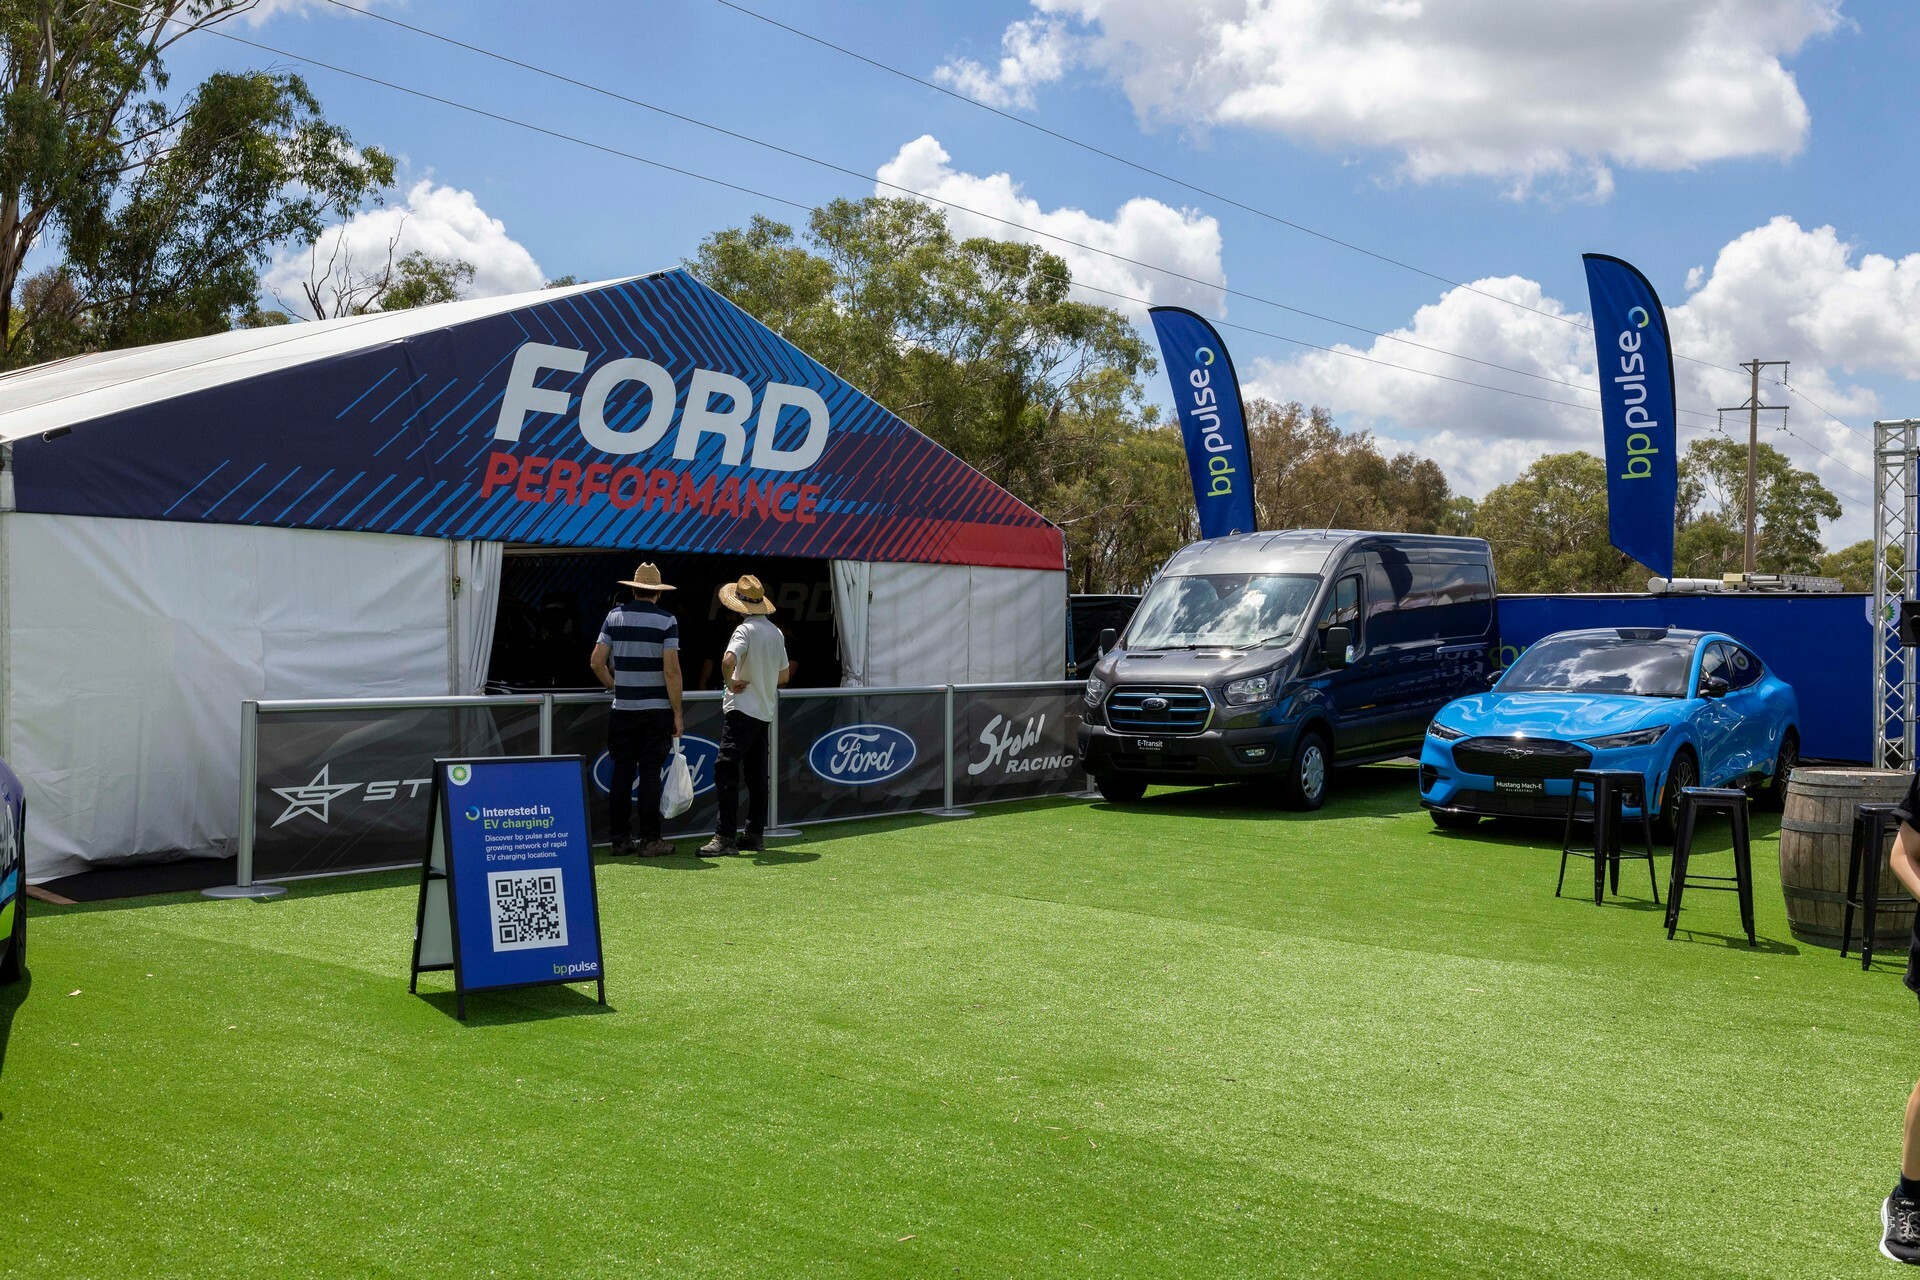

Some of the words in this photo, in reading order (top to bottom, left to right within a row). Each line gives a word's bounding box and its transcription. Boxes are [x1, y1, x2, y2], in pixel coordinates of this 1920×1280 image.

[493, 341, 831, 472] FORD
[480, 451, 822, 524] PERFORMANCE
[1137, 739, 1163, 748] E-Transit
[830, 733, 896, 774] Ford
[1005, 754, 1074, 774] RACING
[1496, 781, 1520, 789] Mustang
[1521, 782, 1543, 790] Mach-E
[482, 805, 538, 818] Interested
[540, 804, 551, 815] in
[483, 819, 499, 830] EV
[502, 816, 555, 830] charging?
[484, 834, 513, 842] Discover
[514, 833, 524, 841] bp
[525, 832, 543, 841] pulse
[544, 831, 556, 839] and
[485, 844, 513, 853] growing
[514, 842, 541, 850] network
[550, 840, 567, 849] rapid
[497, 853, 526, 861] charging
